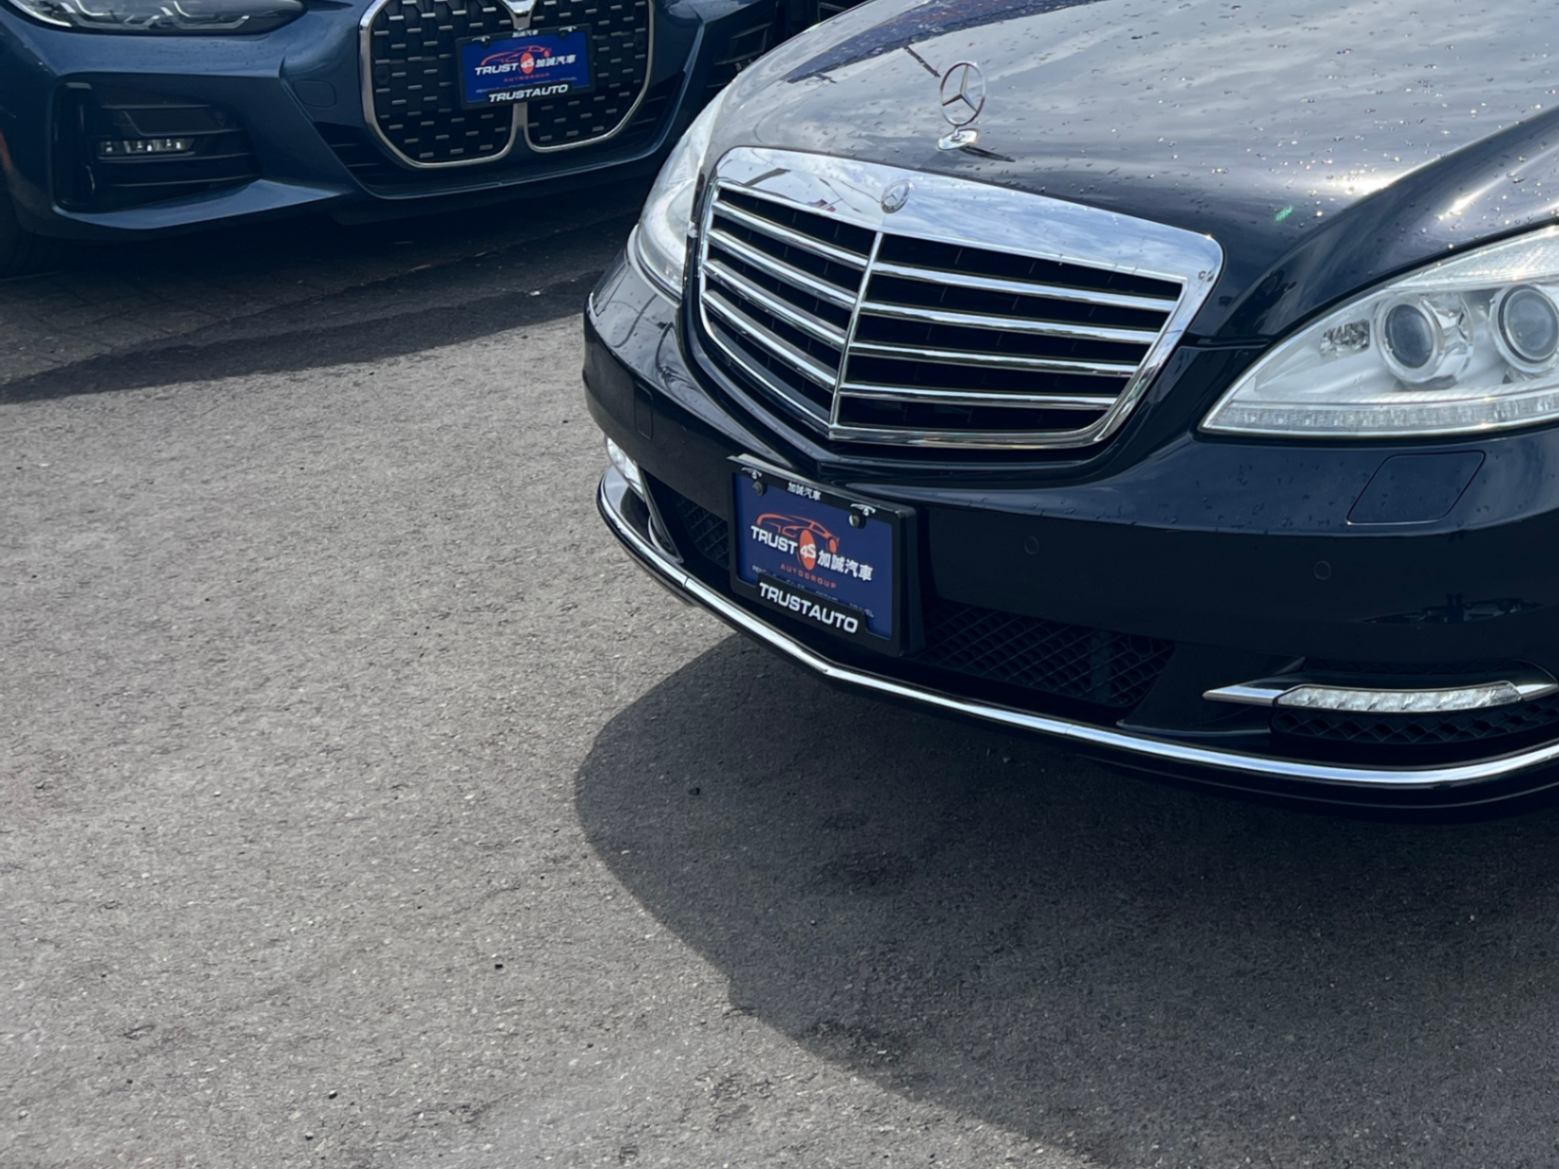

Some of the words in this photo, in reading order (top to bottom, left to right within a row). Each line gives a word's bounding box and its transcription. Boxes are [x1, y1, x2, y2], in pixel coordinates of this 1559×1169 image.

[475, 62, 519, 76] TRUST
[488, 84, 569, 103] TRUSTAUTO
[751, 525, 798, 555] TRUST
[800, 544, 817, 559] 4S
[817, 550, 873, 581] 加誠汽車
[759, 582, 859, 633] TRUSTAUTO
